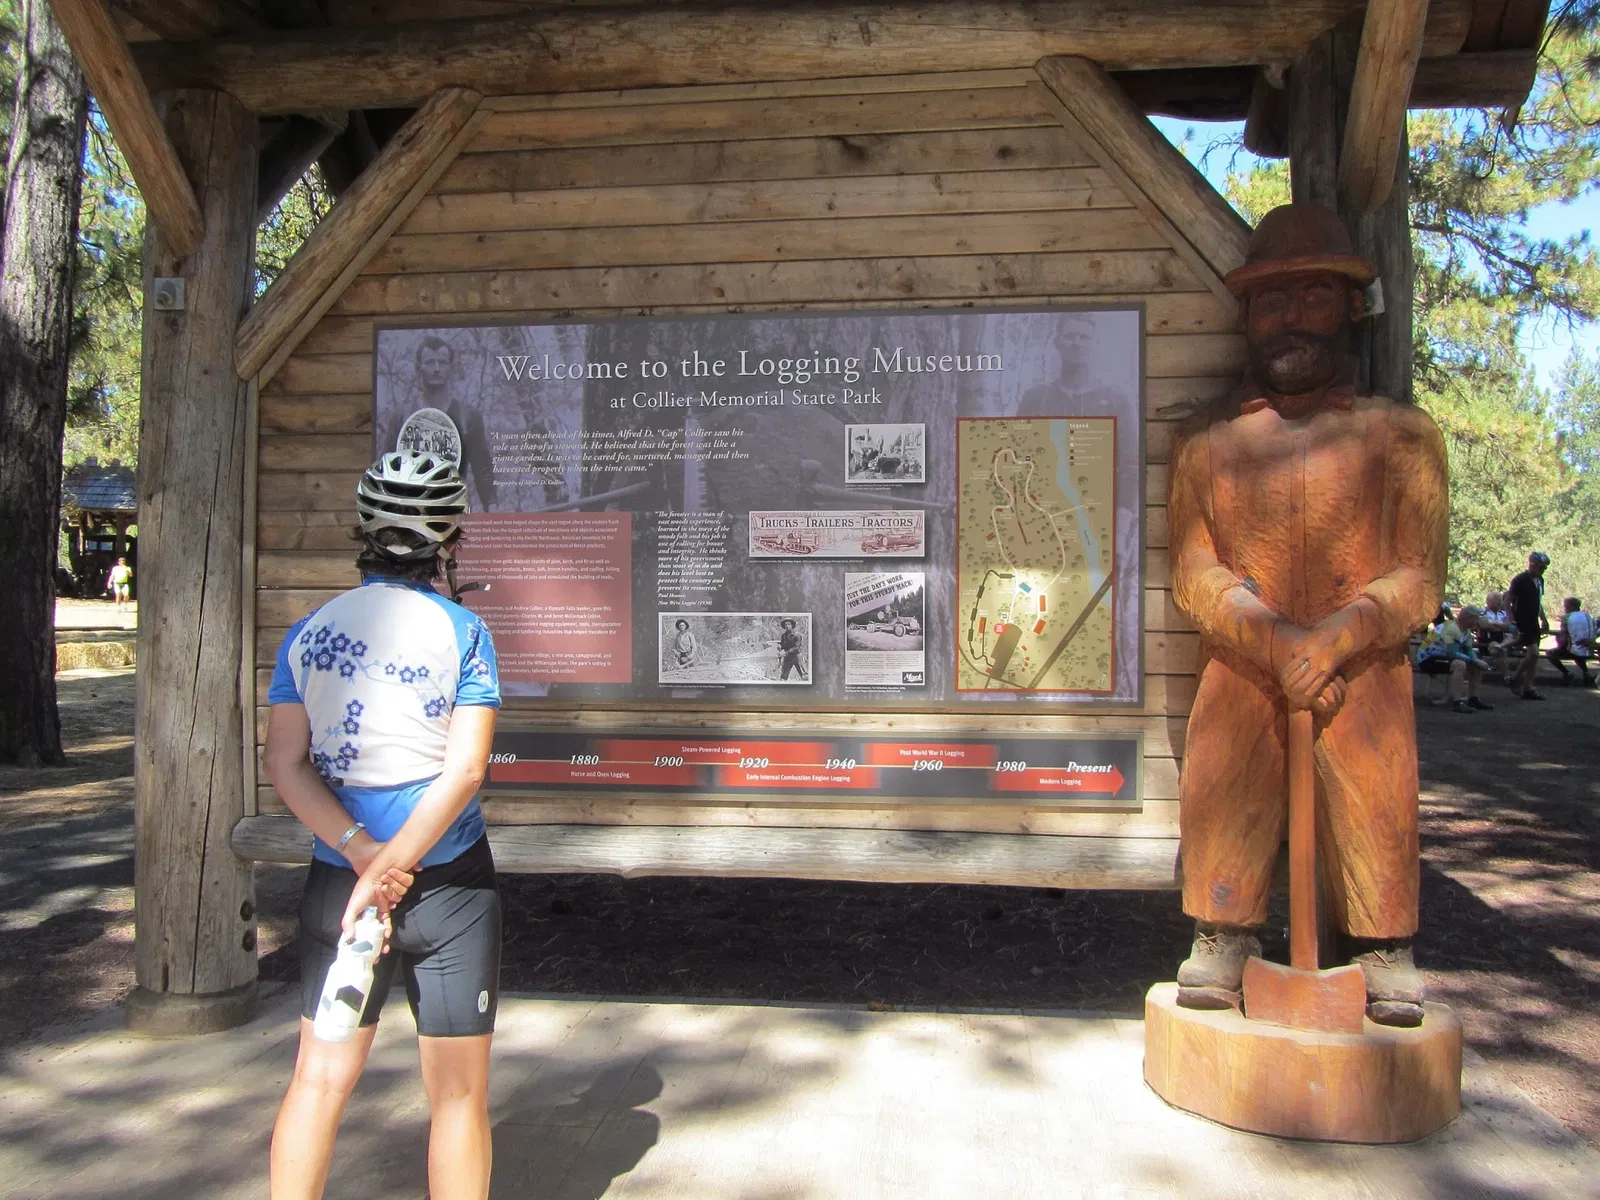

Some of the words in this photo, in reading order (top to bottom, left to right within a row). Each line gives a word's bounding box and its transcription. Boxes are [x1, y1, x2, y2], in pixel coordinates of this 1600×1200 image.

[496, 354, 627, 380] Welcome
[640, 358, 668, 378] to
[681, 350, 725, 377] the
[738, 350, 859, 384] Logging
[872, 347, 1004, 373] Museum
[610, 396, 626, 408] at
[633, 391, 693, 408] Collier
[700, 390, 784, 406] Memorial
[792, 389, 835, 405] State
[843, 388, 882, 405] Park
[521, 431, 540, 441] often
[542, 431, 566, 439] ahead
[567, 430, 576, 441] of
[577, 430, 590, 438] his
[591, 430, 615, 440] times,
[617, 429, 645, 440] Alfred
[684, 429, 712, 437] Collier
[731, 428, 745, 436] his
[493, 442, 508, 451] role
[520, 442, 536, 450] that
[537, 442, 546, 452] of
[590, 441, 602, 449] He
[604, 441, 636, 449] believed
[638, 441, 656, 449] that
[657, 440, 670, 448] the
[671, 440, 694, 450] forest
[713, 440, 728, 448] like
[493, 453, 514, 464] giant
[515, 453, 545, 464] garden.
[572, 453, 581, 461] to
[583, 452, 592, 460] be
[593, 452, 615, 460] cared
[617, 452, 631, 462] for,
[633, 452, 672, 462] nurtured,
[673, 451, 711, 462] managed
[713, 451, 729, 459] and
[731, 451, 750, 459] then
[493, 464, 530, 472] harvested
[532, 464, 565, 474] properly
[567, 464, 588, 472] when
[590, 464, 602, 472] the
[604, 464, 622, 472] time
[760, 517, 798, 528] TRUCKS
[805, 517, 854, 527] TRAILERS
[861, 516, 913, 527] TRACTORS
[860, 586, 870, 595] THE
[886, 574, 903, 584] WORK
[849, 599, 860, 608] FOR
[861, 594, 874, 603] THIS
[875, 586, 895, 598] STURDY
[904, 673, 922, 682] Mack
[488, 752, 516, 764] 1860
[570, 754, 599, 765] 1880
[654, 756, 683, 767] 1900
[738, 757, 769, 768] 1920
[825, 758, 856, 770] 1940
[912, 760, 943, 771] 1960
[995, 761, 1026, 772] 1980
[1067, 761, 1112, 772] Present
